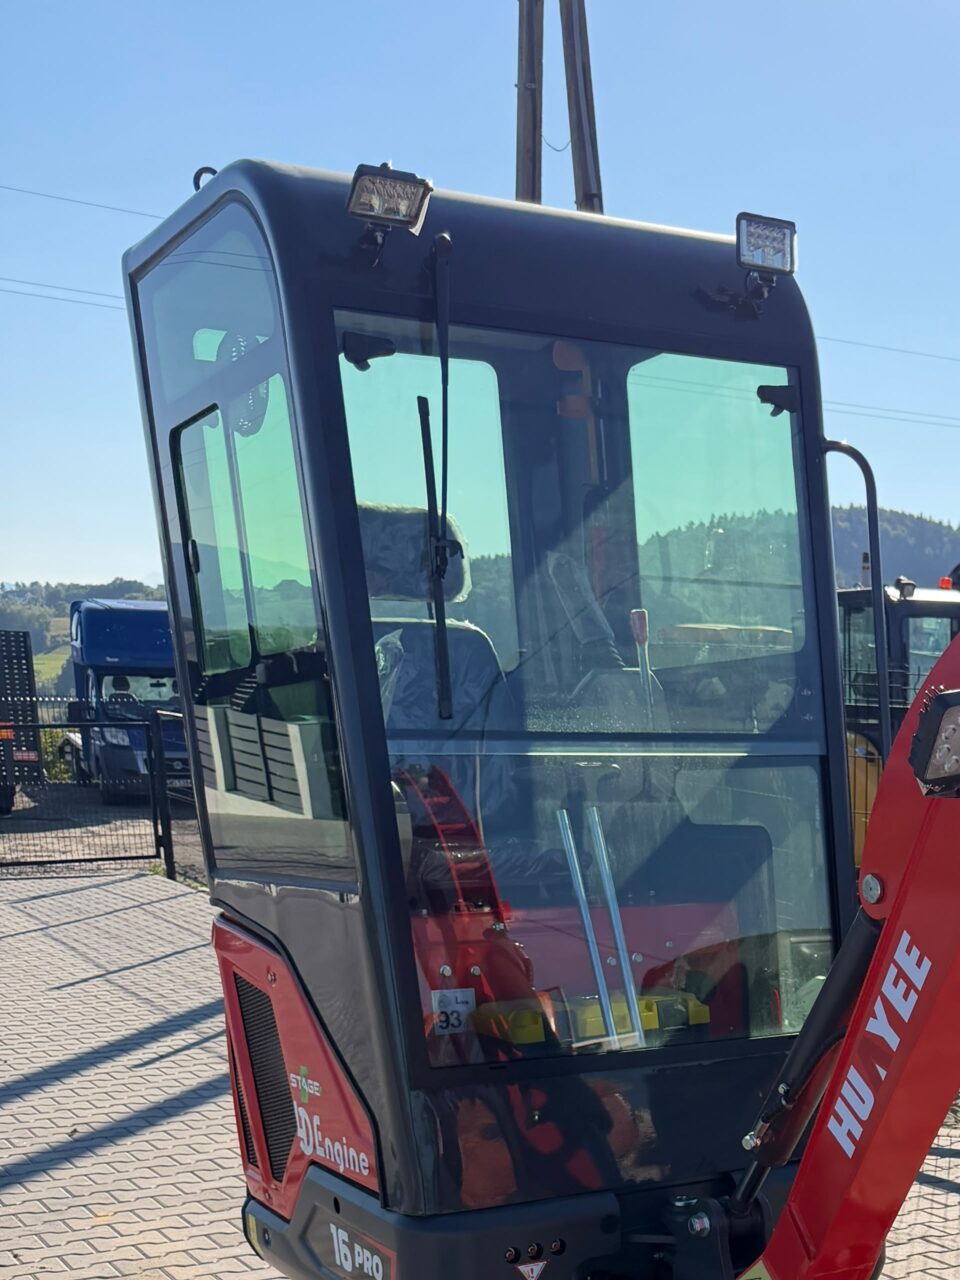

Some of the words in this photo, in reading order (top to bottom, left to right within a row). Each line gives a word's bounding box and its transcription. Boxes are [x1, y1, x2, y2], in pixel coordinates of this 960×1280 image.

[439, 1010, 462, 1030] 93
[313, 1114, 369, 1176] Engine
[329, 1223, 353, 1273] 16
